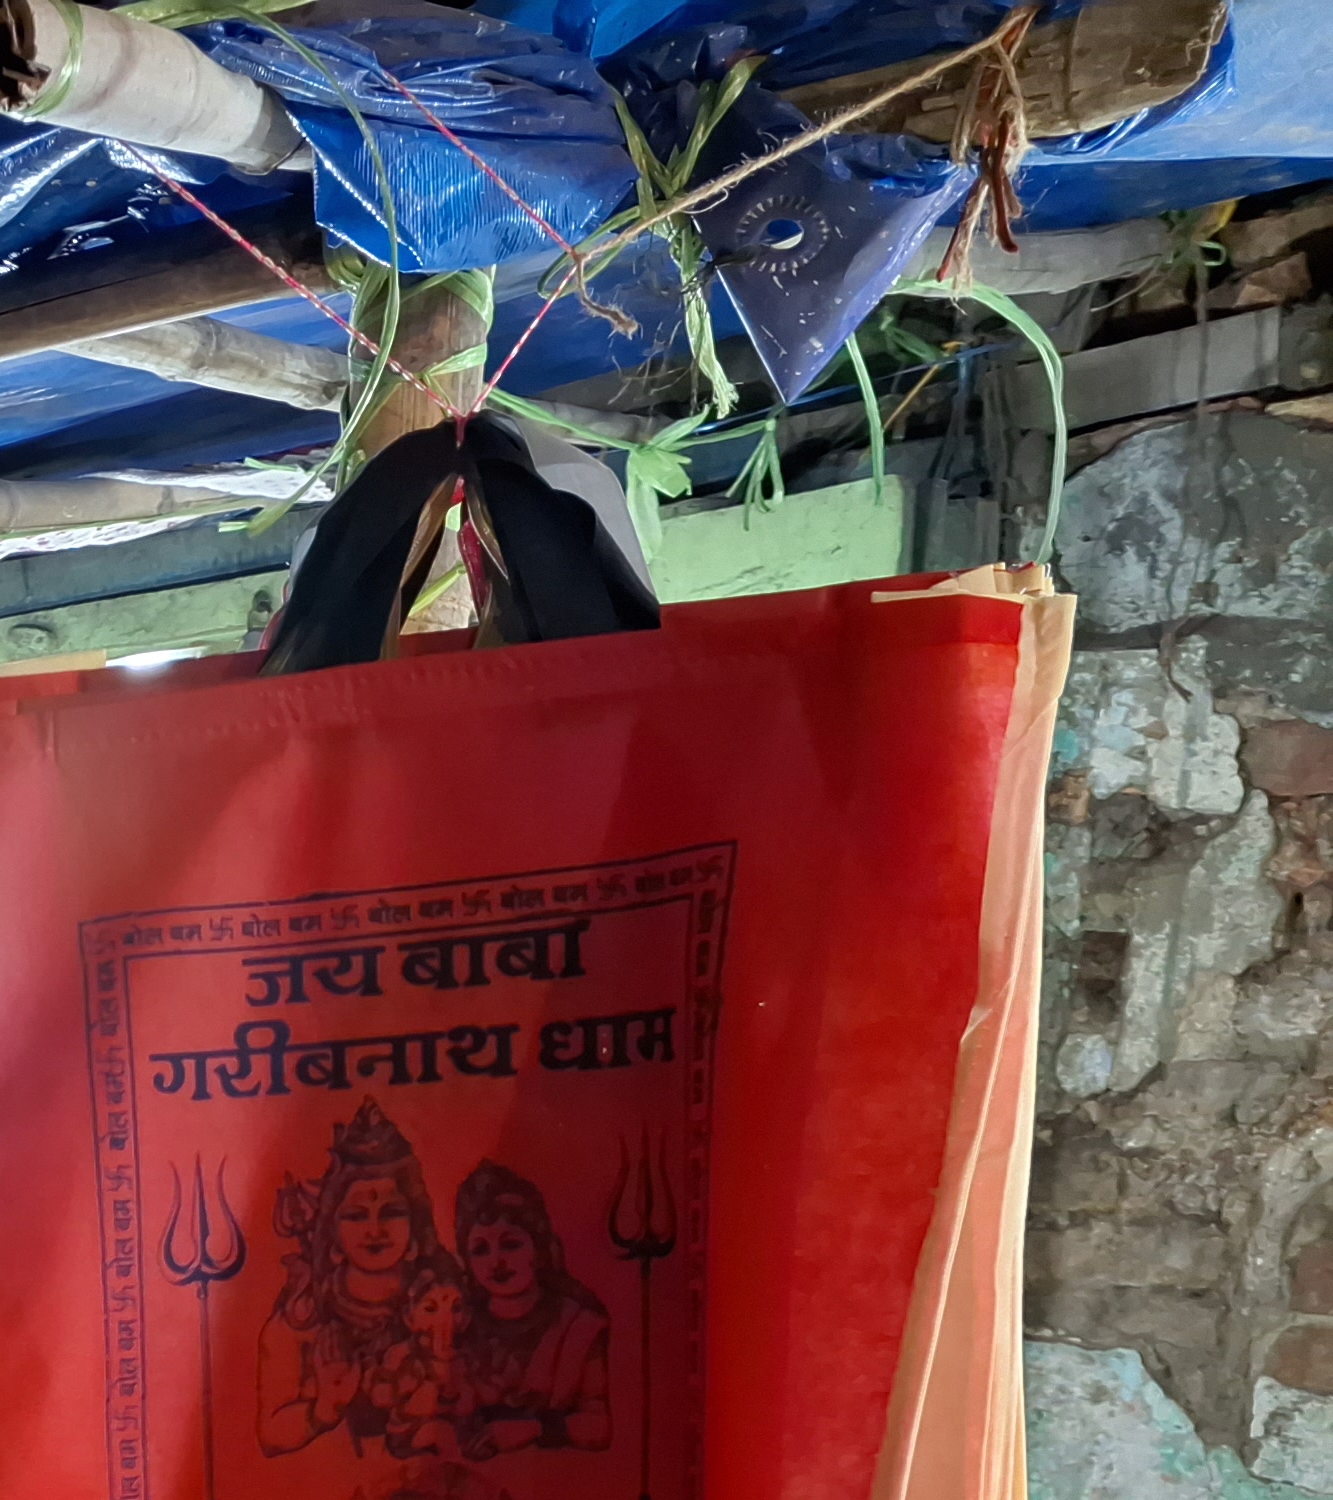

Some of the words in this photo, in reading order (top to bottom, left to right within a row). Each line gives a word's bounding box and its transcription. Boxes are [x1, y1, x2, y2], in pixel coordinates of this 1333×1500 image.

[241, 946, 386, 1007] जय
[397, 918, 591, 989] बाबा
[148, 1018, 522, 1101] गरीबनाथ
[537, 1006, 678, 1072] धाम
